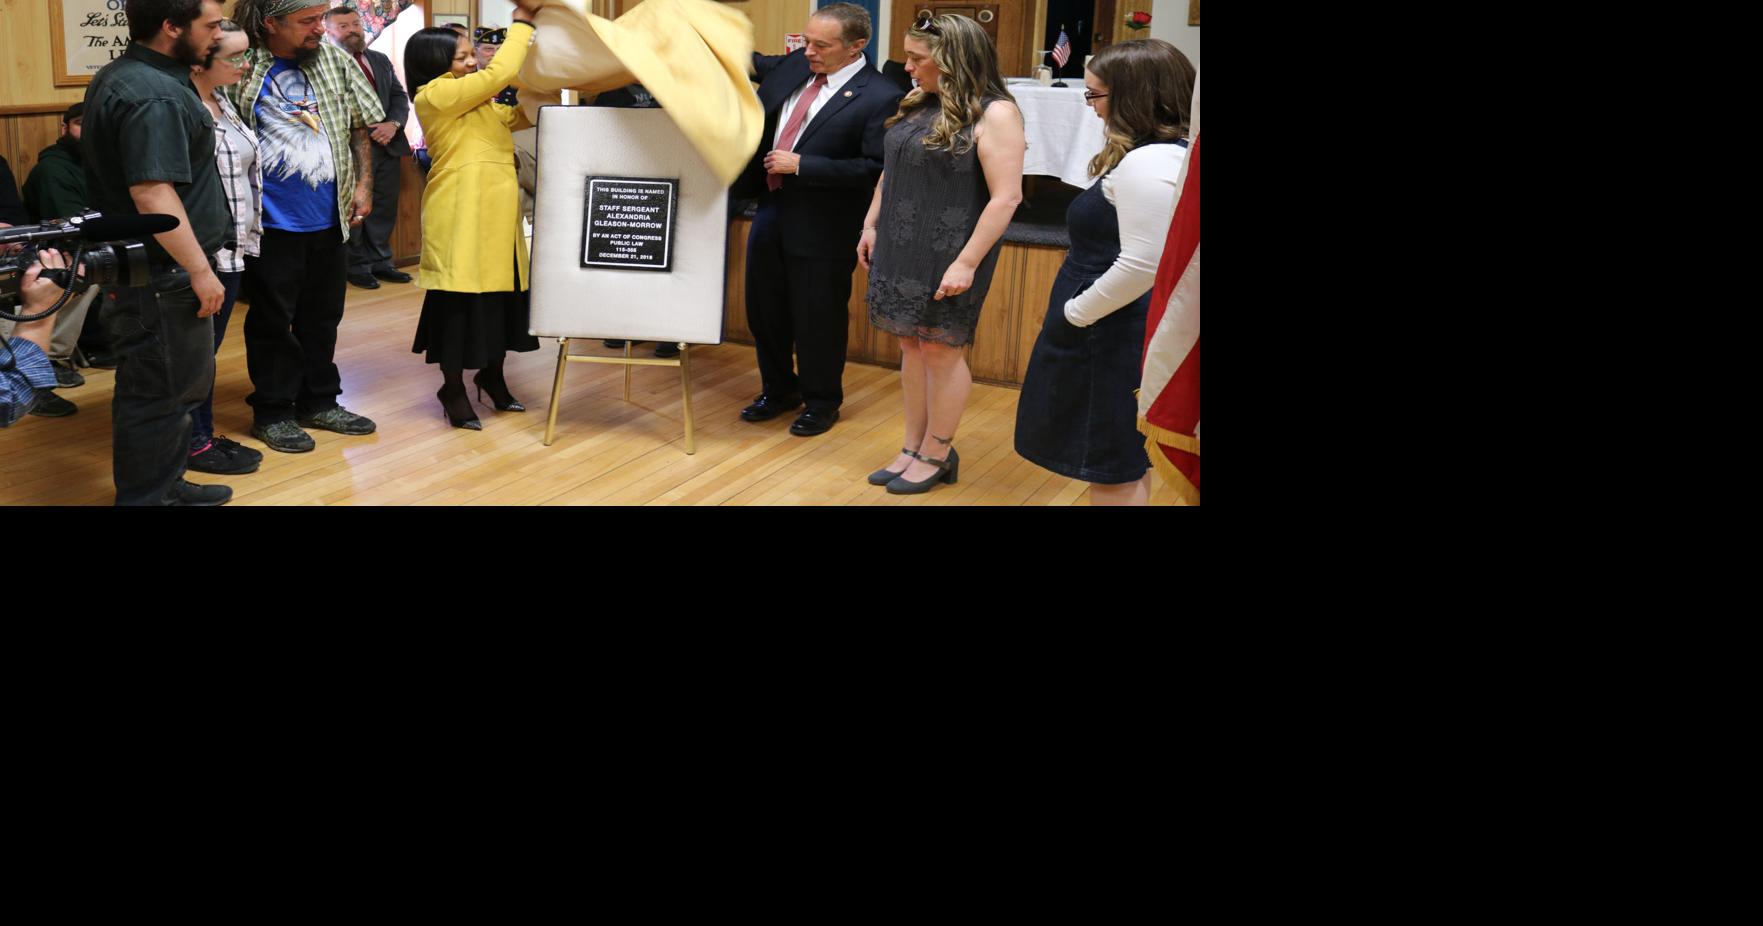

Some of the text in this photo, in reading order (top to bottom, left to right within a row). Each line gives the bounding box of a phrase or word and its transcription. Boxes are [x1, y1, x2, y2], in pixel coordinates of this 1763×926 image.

[80, 12, 109, 27] Let's
[83, 35, 109, 47] The
[622, 205, 659, 213] SERGEANT
[594, 220, 662, 229] GLEASON-MORROW
